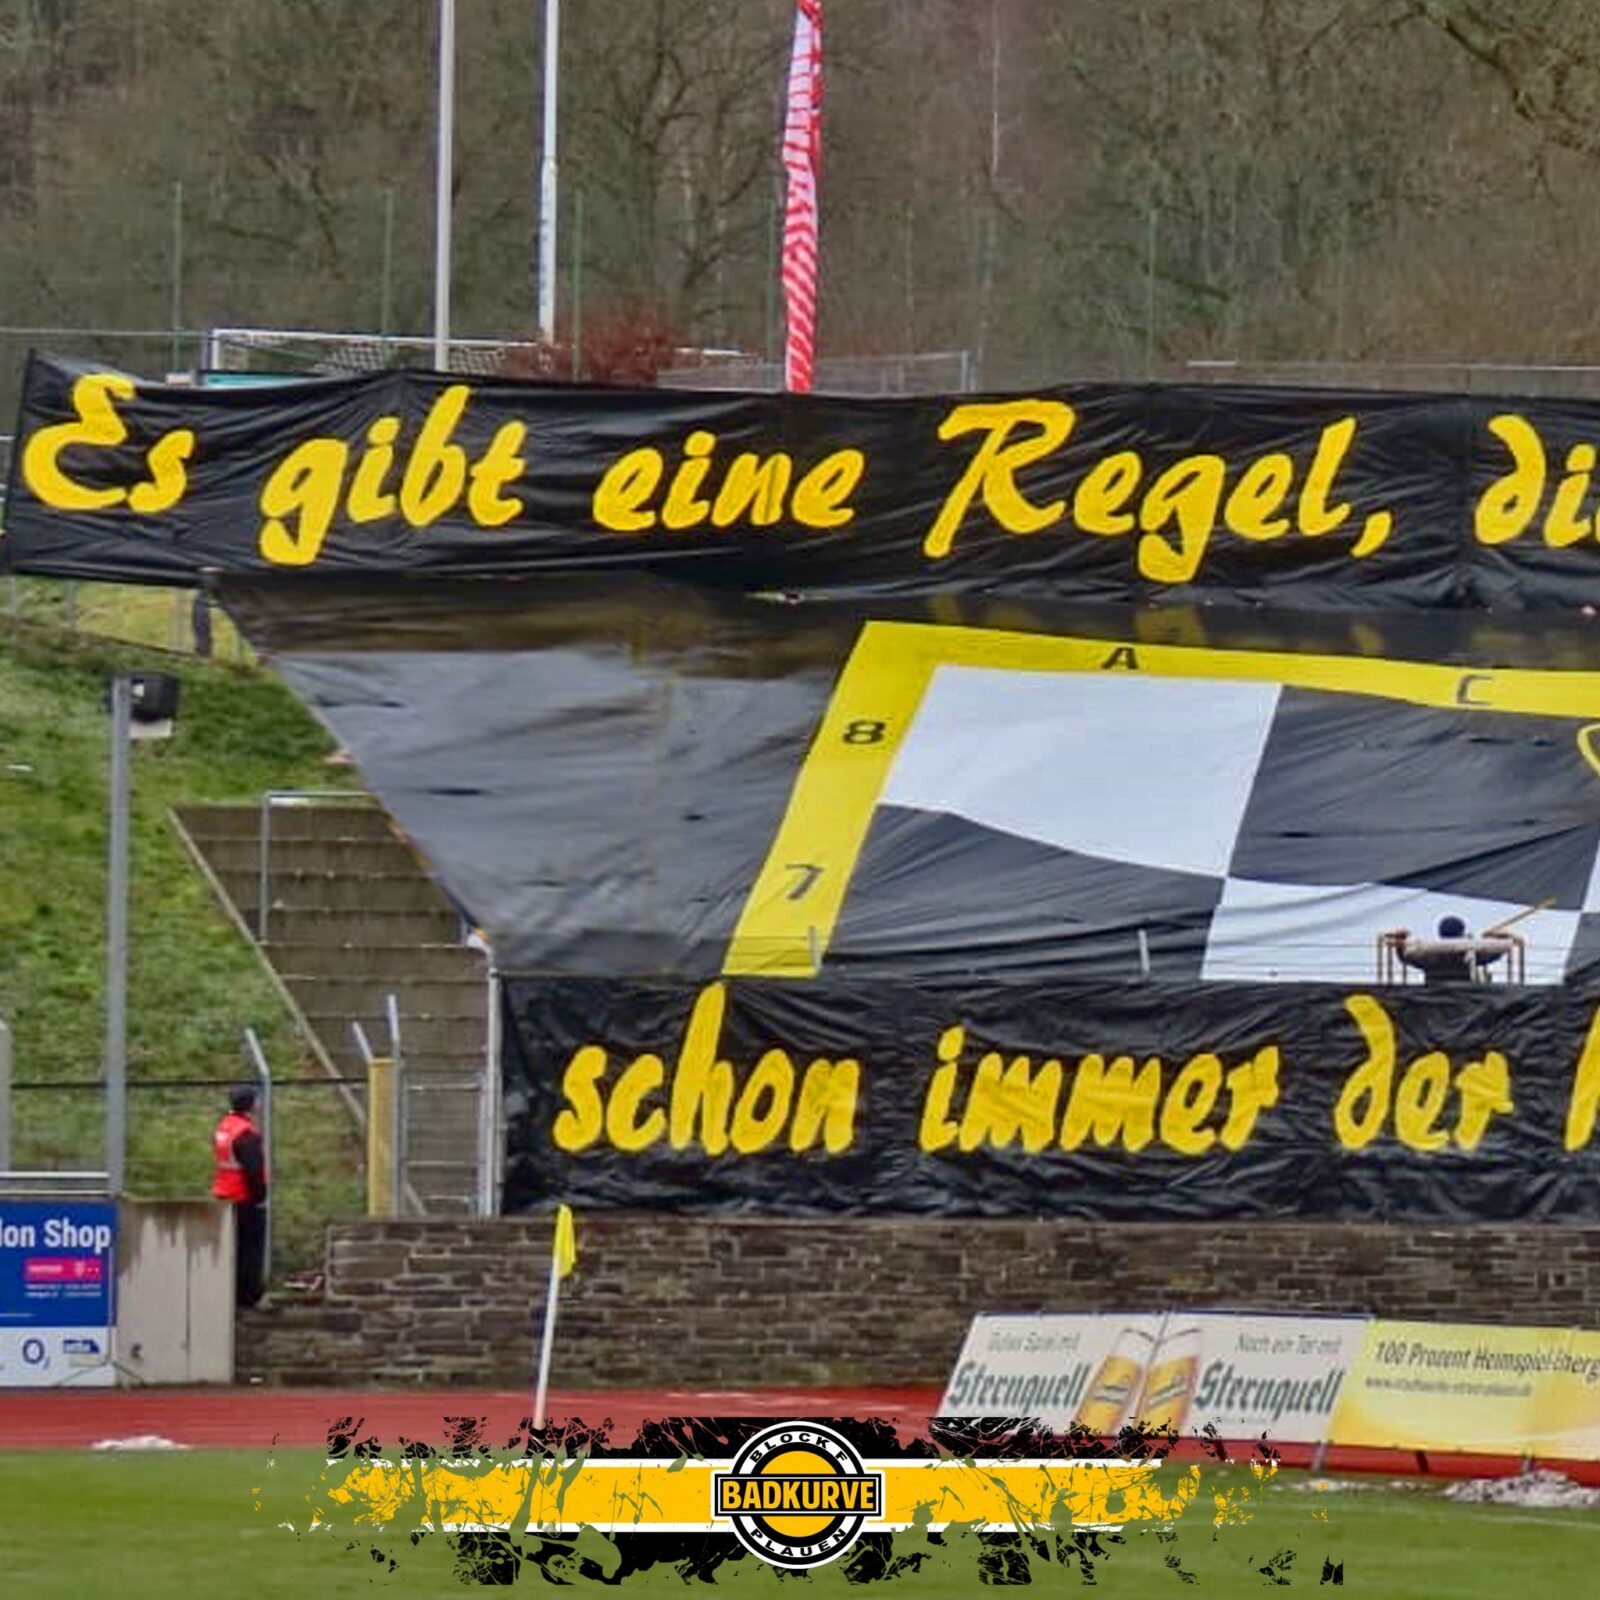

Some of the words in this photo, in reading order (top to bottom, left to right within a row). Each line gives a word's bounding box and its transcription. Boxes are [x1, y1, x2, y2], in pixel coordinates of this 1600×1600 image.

[22, 374, 194, 514] Es
[259, 385, 526, 565] gibt
[593, 431, 864, 531] eine
[924, 399, 1392, 583] Regel,
[1475, 416, 1600, 547] di
[1101, 647, 1138, 670] A
[1457, 674, 1493, 705] C
[843, 720, 886, 745] 8
[785, 864, 824, 900] 7
[553, 981, 860, 1155] schon
[919, 1026, 1279, 1155] immer
[1334, 995, 1513, 1151] der
[44, 1217, 111, 1254] Shop
[1376, 1341, 1408, 1366] 100
[1407, 1343, 1472, 1370] Prozent
[948, 1360, 1092, 1417] Sternquell
[1195, 1360, 1345, 1422] Sternquell
